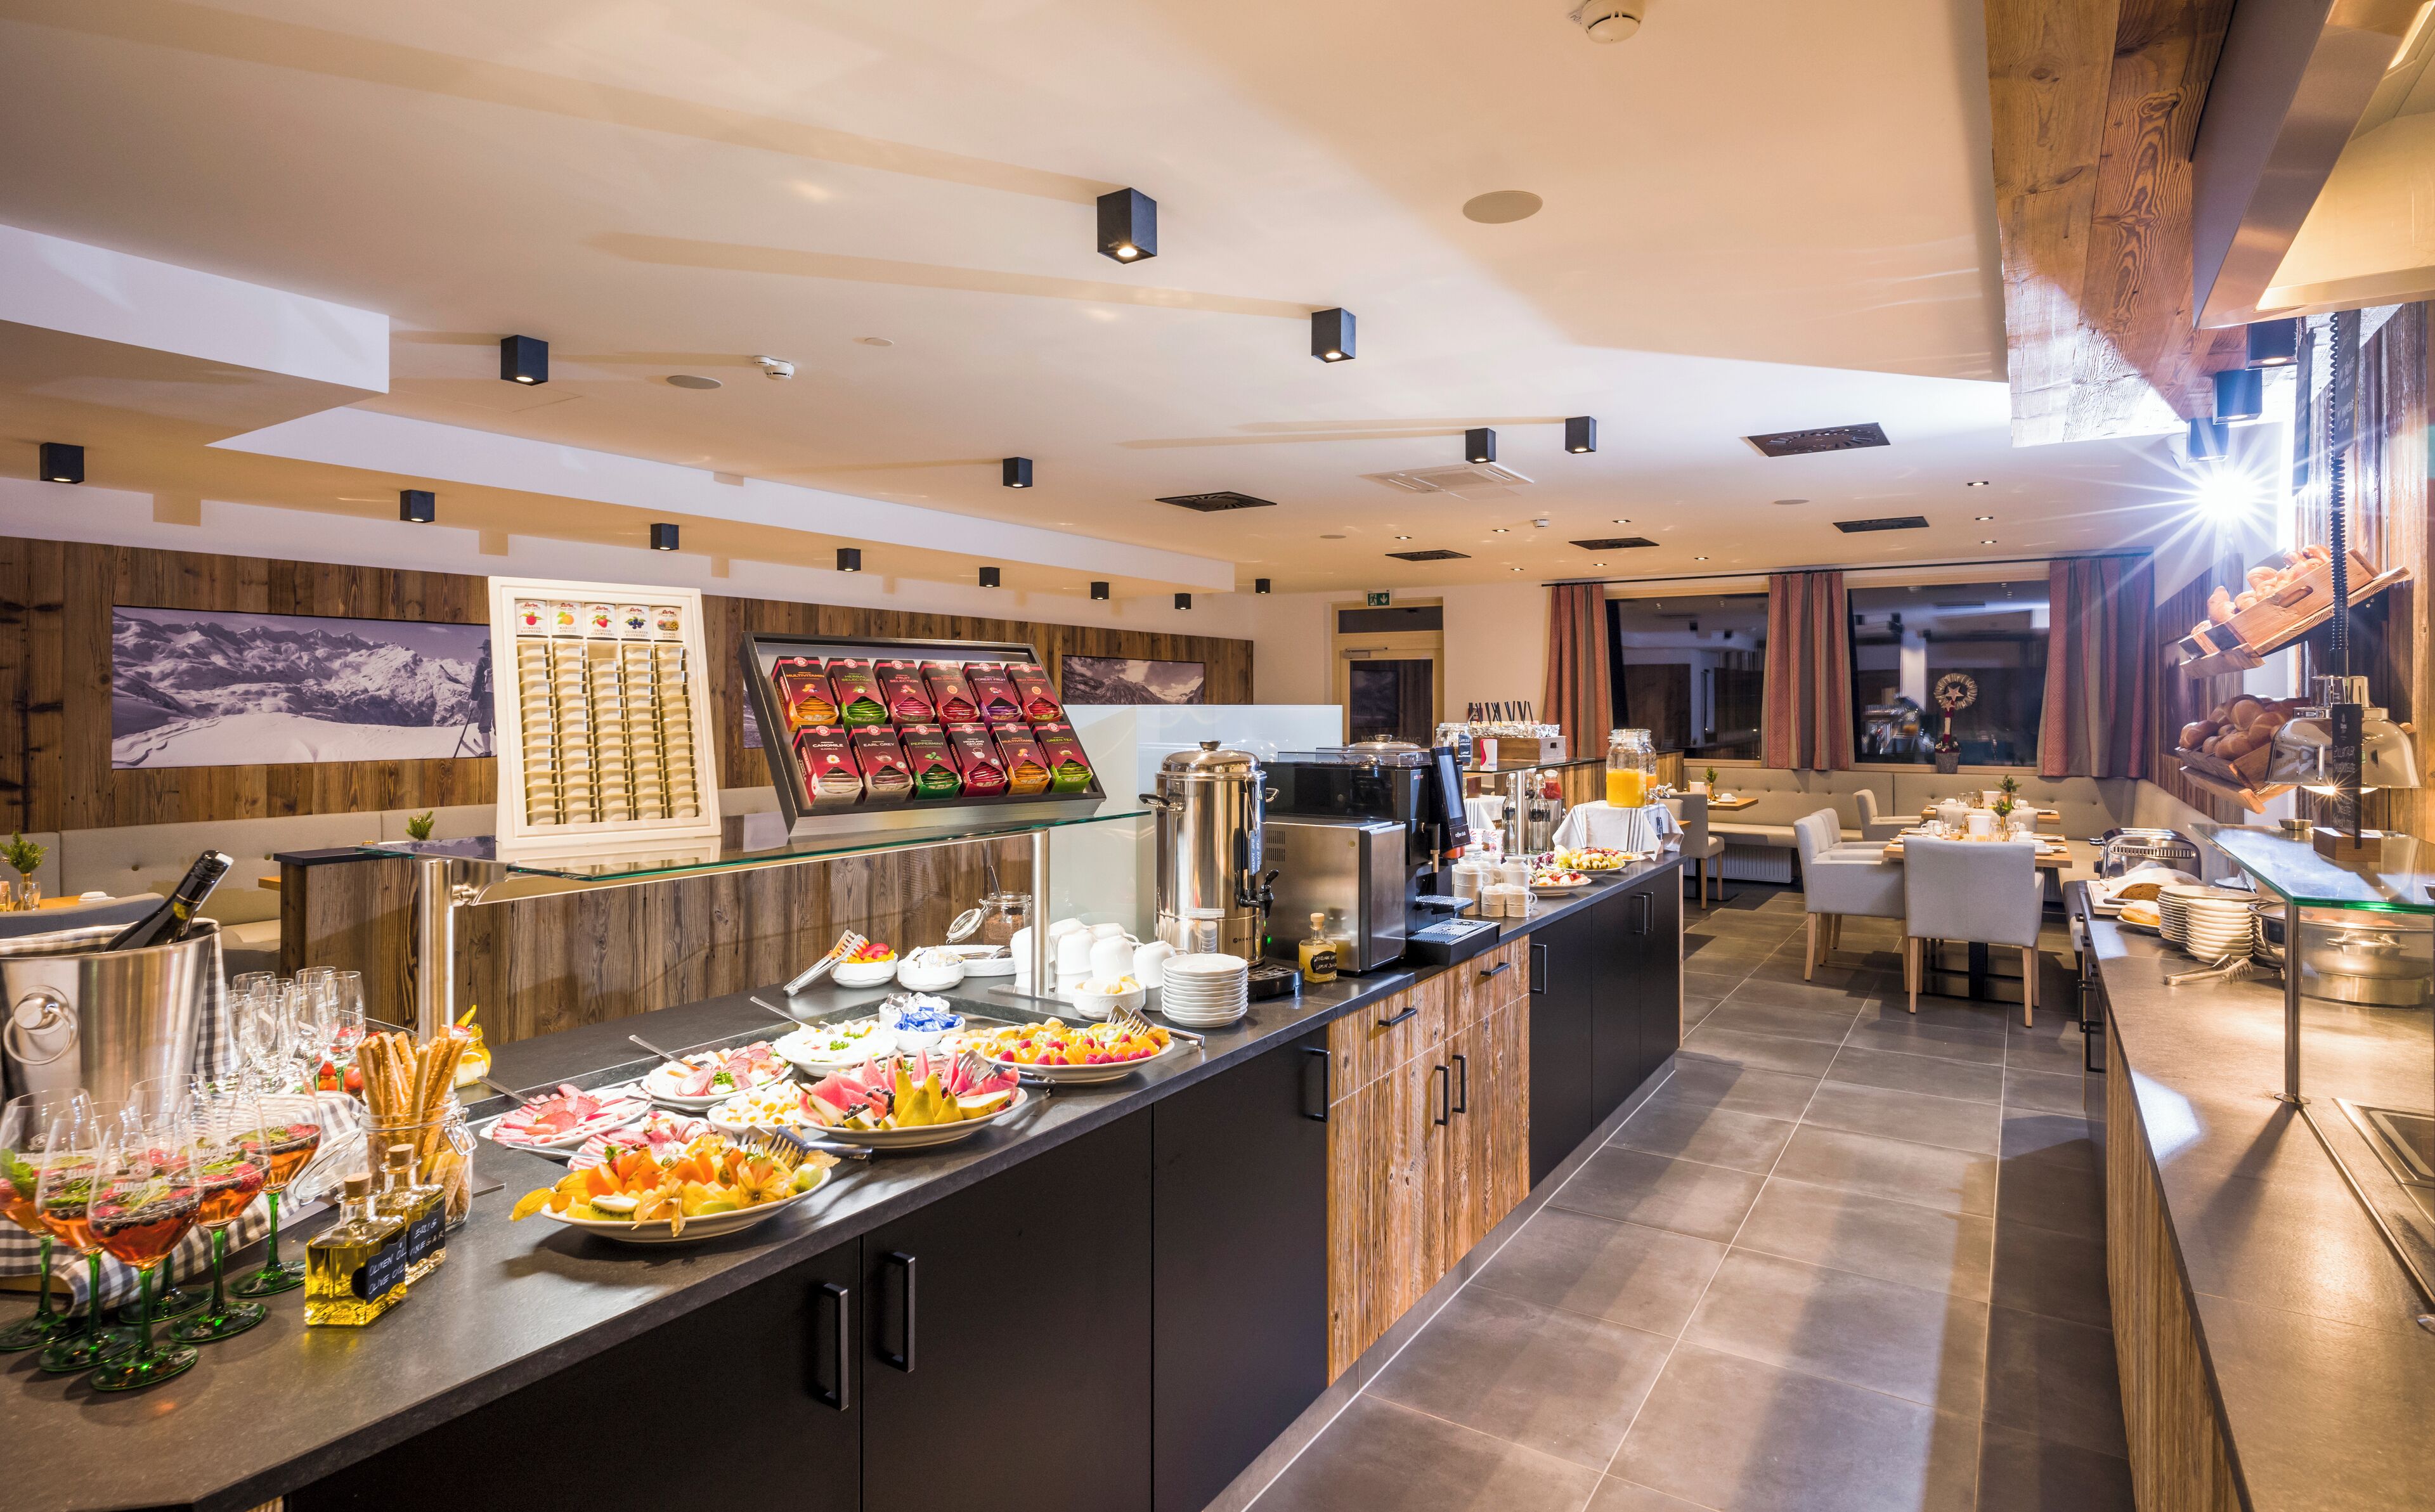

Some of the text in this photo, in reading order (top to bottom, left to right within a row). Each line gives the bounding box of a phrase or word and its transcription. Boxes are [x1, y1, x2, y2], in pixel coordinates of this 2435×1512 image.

[414, 1218, 437, 1239] ESSIG
[369, 1253, 393, 1276] OLIVEN
[368, 1263, 405, 1295] OLIVE OIL
